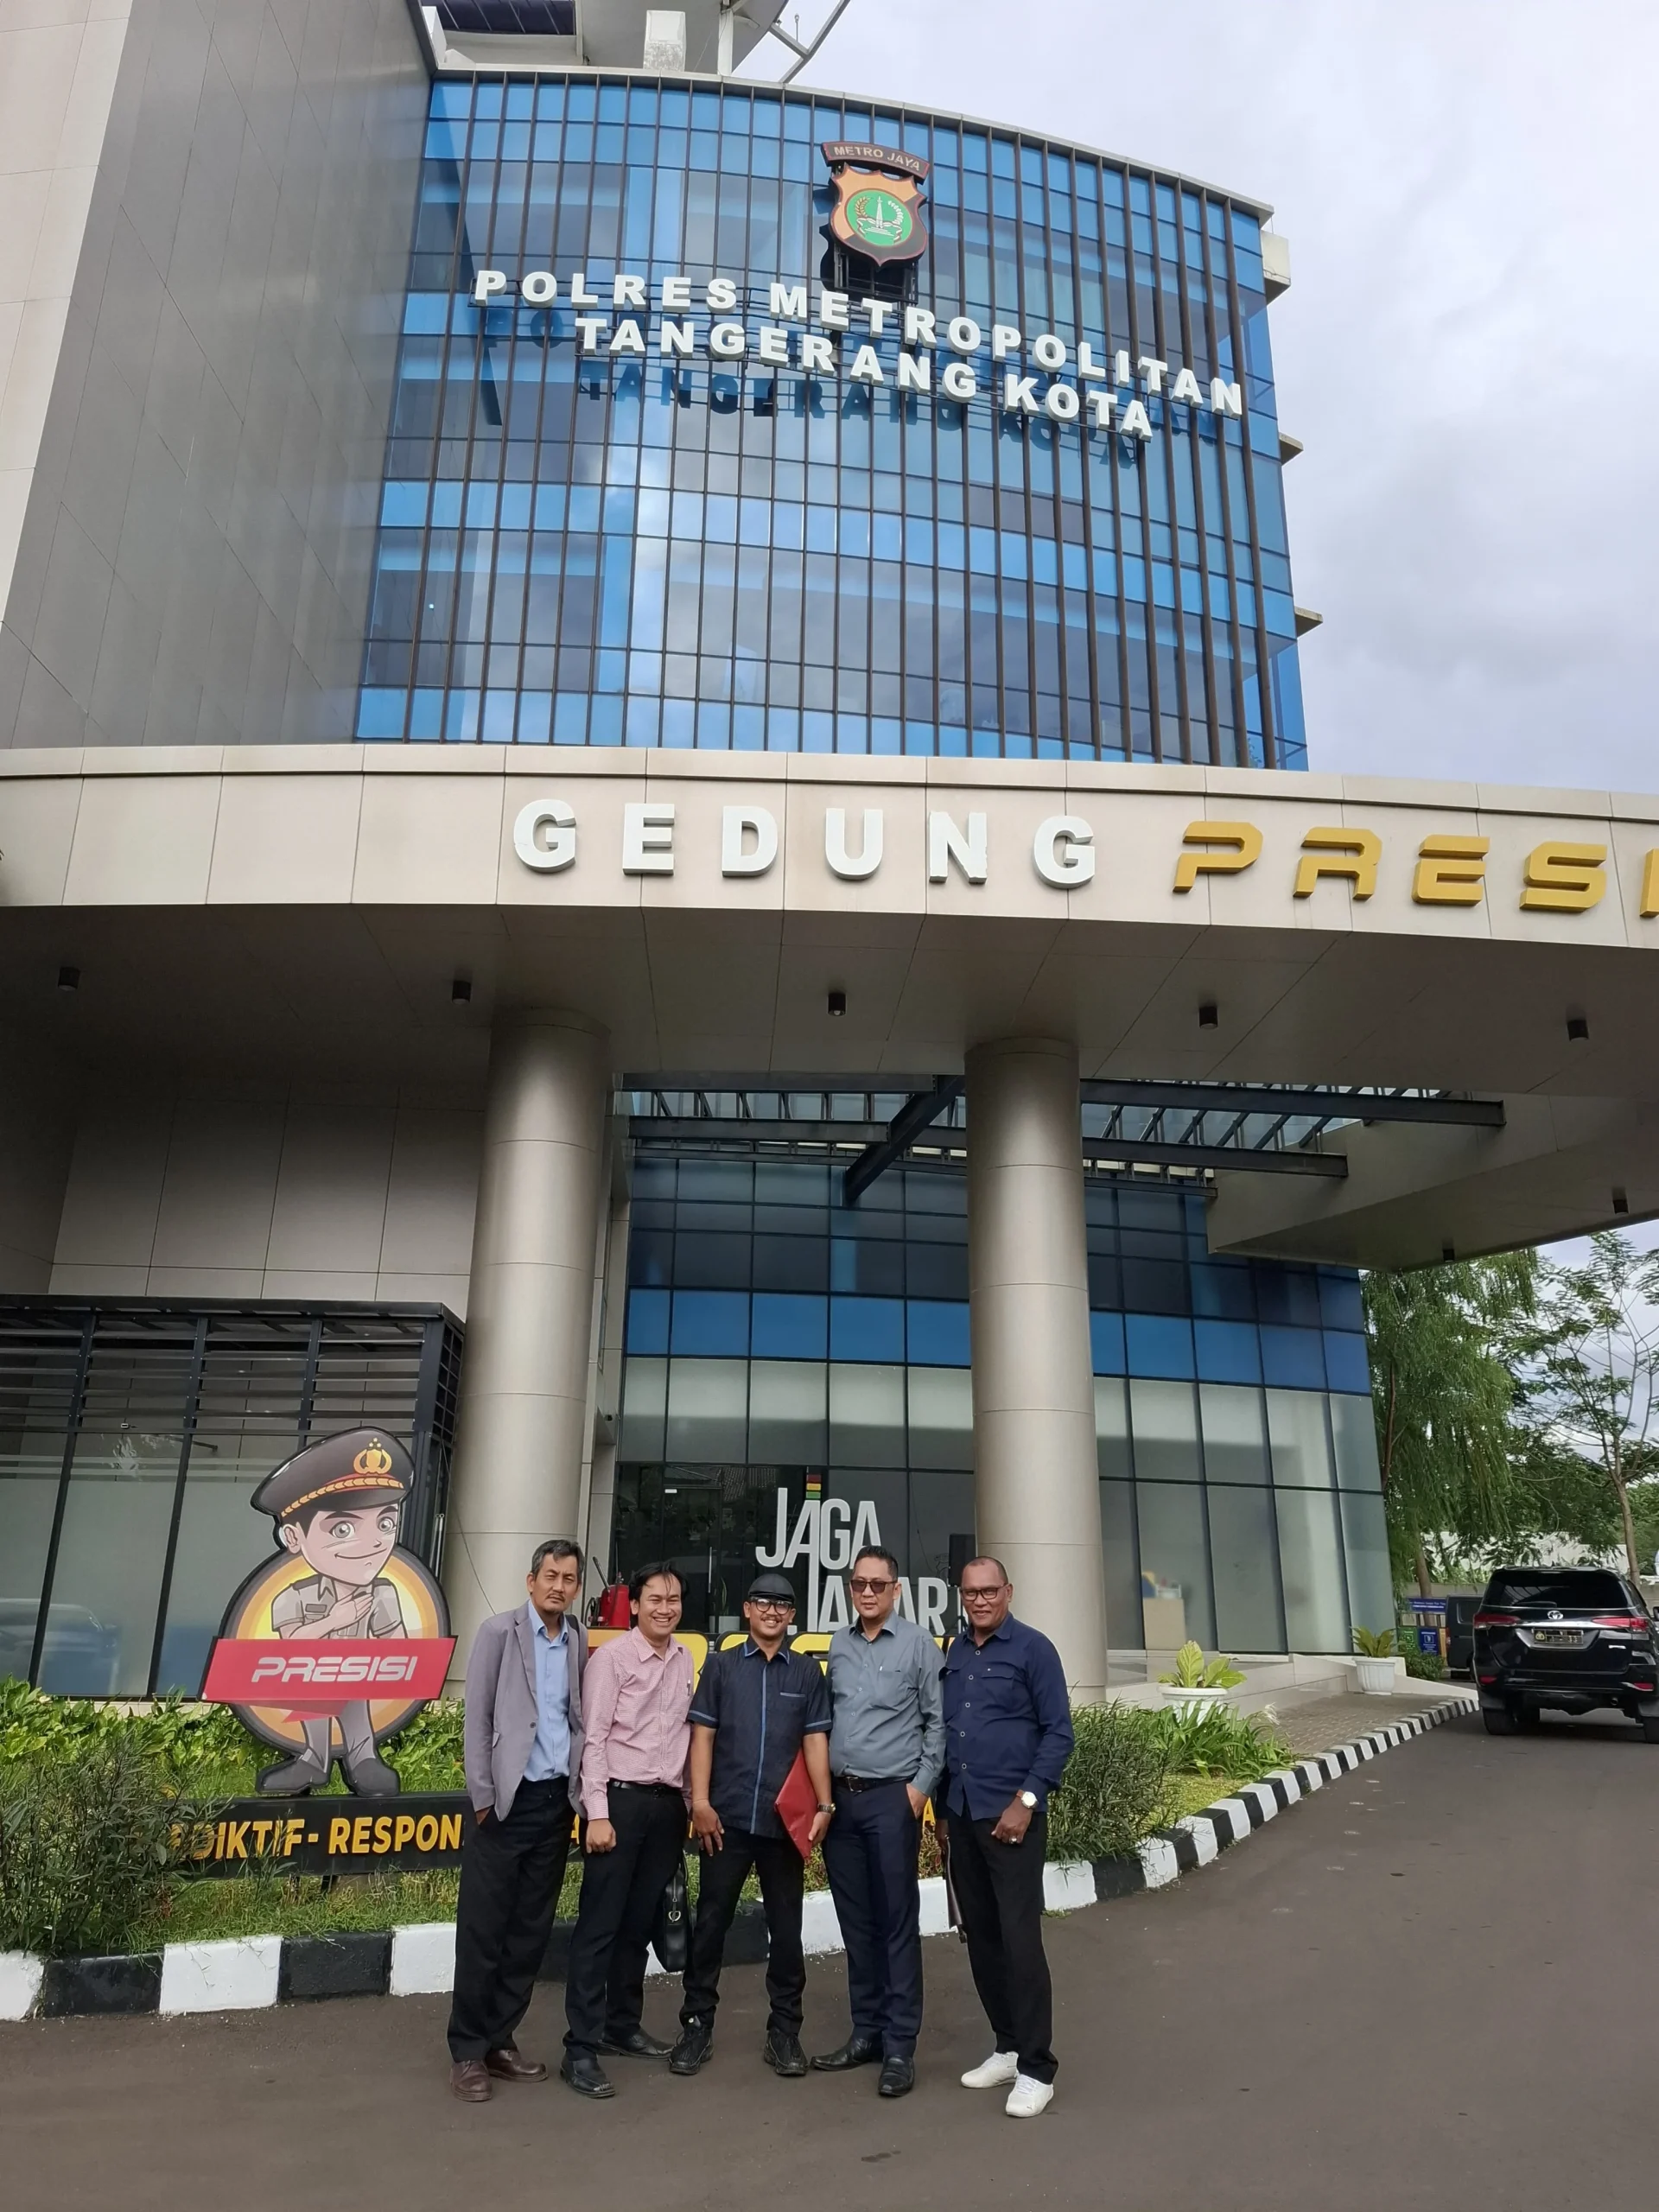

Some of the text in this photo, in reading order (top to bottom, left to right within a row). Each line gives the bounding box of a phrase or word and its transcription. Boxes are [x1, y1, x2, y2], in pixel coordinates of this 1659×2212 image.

[833, 145, 920, 172] METRO JAYA
[474, 270, 1243, 419] POLRES METROPOLITAN
[575, 317, 1154, 442] TANGERANG KOTA
[513, 798, 1096, 890] GEDUNG
[755, 1487, 881, 1570] JAGA
[251, 1656, 419, 1683] PRESISI
[327, 1814, 467, 1855] RESPON
